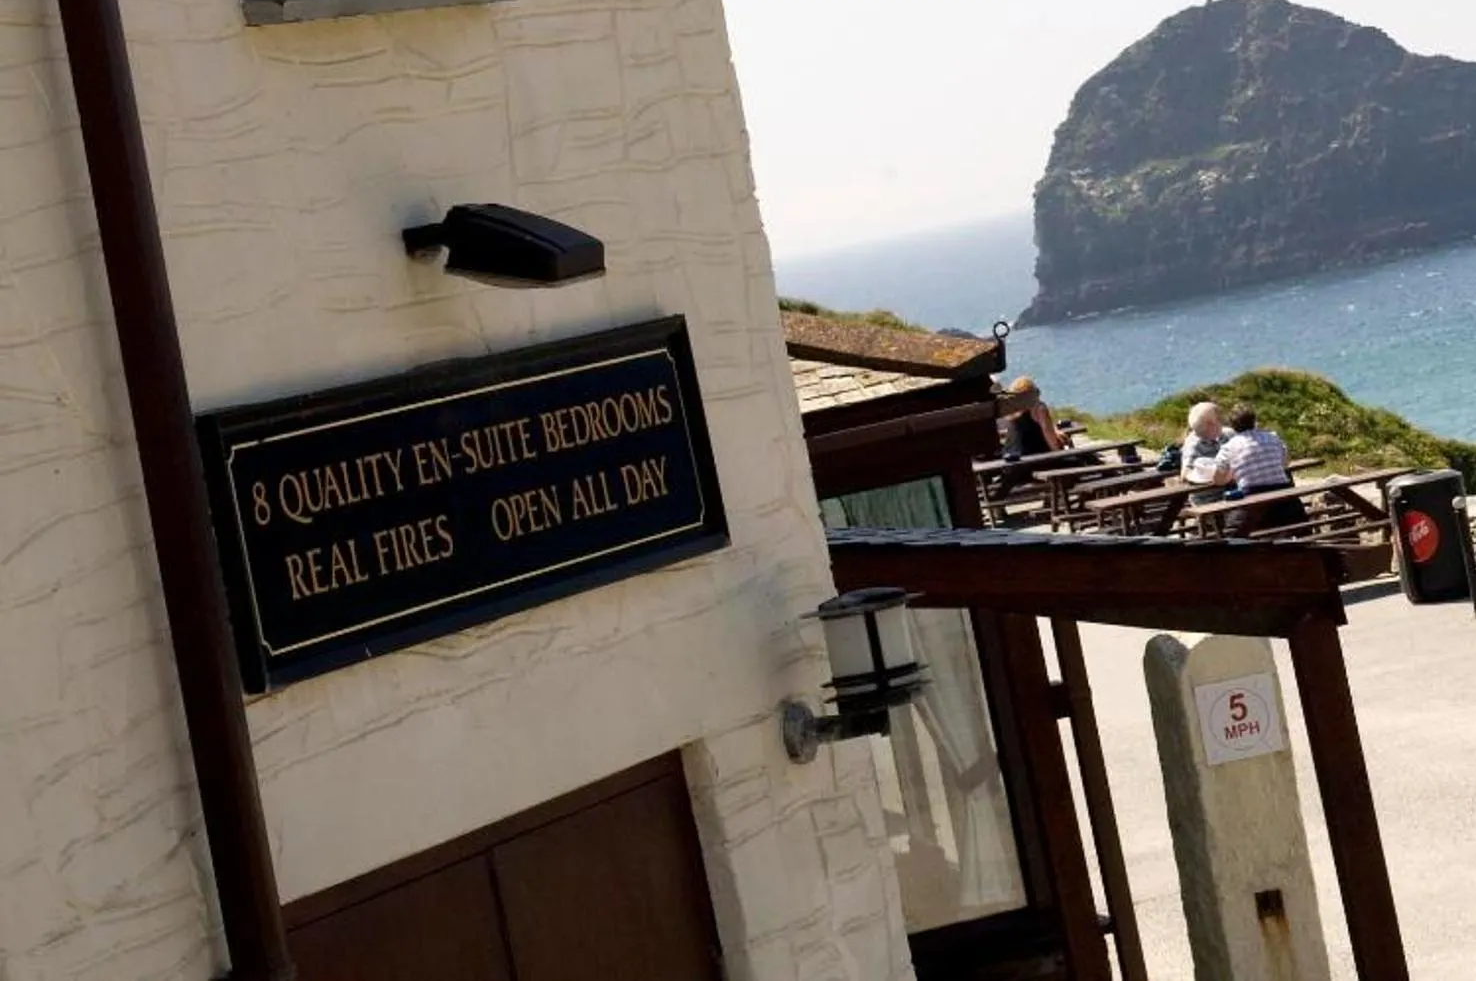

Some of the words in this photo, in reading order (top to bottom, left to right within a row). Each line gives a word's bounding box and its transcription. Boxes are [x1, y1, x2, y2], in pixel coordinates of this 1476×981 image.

[251, 478, 272, 526] 8
[278, 448, 404, 524] QUALITY
[414, 417, 538, 486] EN-SUITE
[541, 383, 675, 453] BEDROOMS
[285, 542, 370, 601] REAL
[372, 513, 456, 577] FIRES
[490, 483, 563, 542] OPEN
[571, 470, 618, 520] ALL
[621, 455, 670, 507] DAY
[1223, 720, 1261, 740] MPH
[1228, 692, 1249, 722] 5
